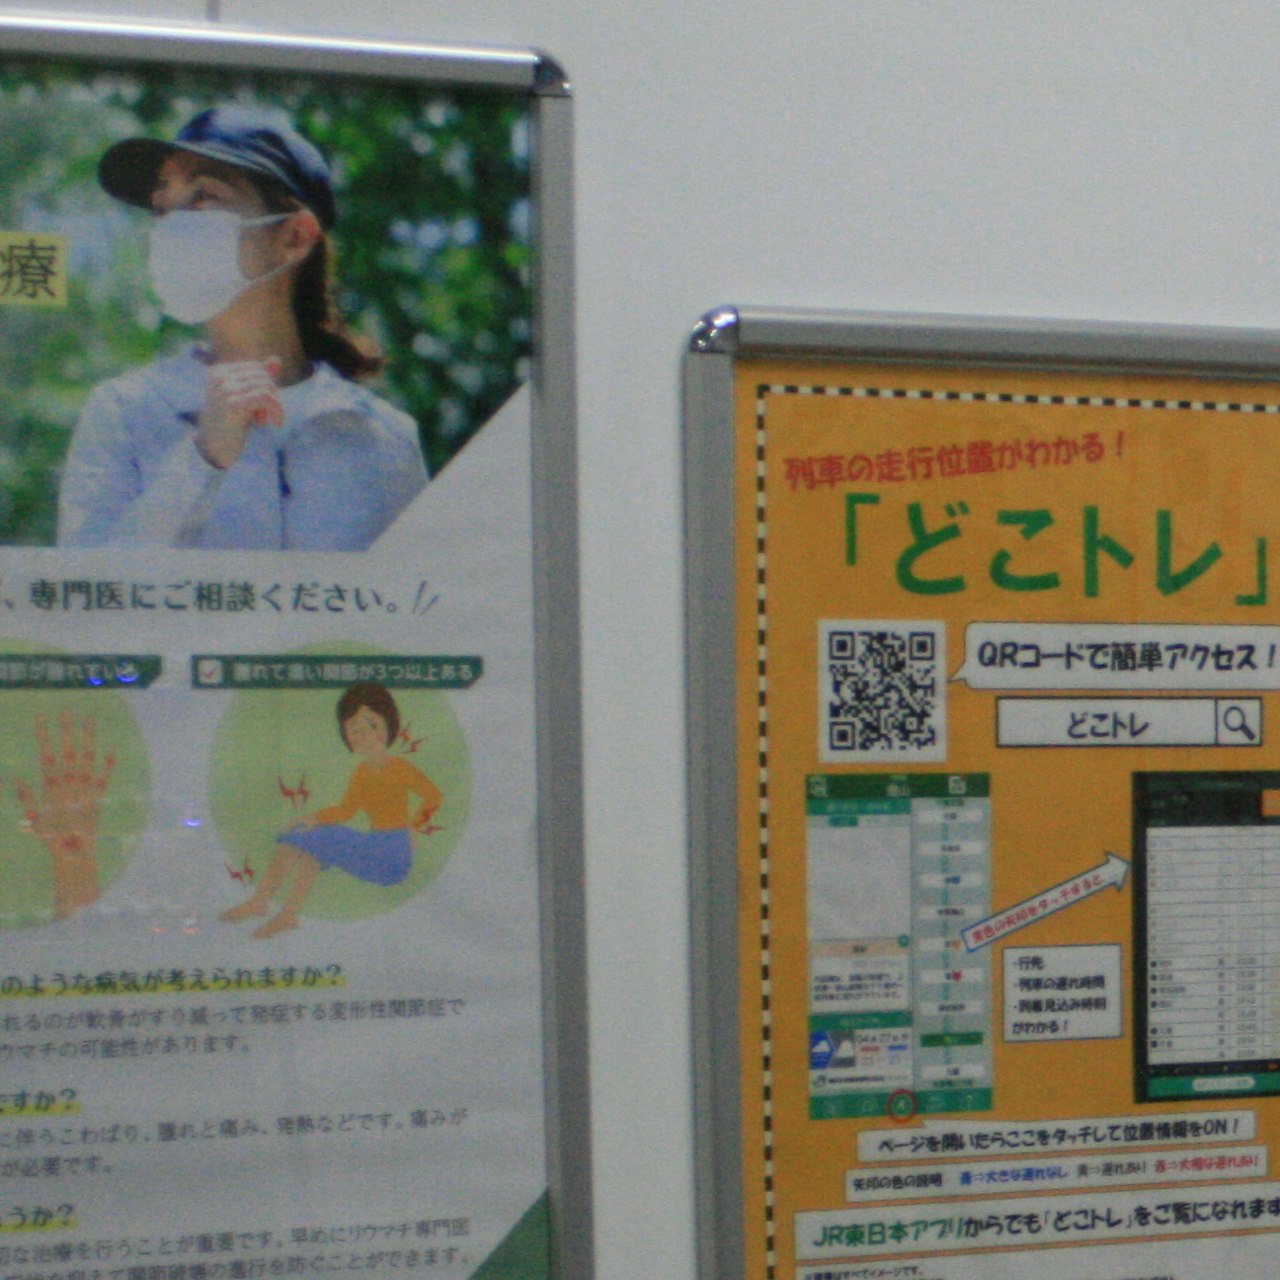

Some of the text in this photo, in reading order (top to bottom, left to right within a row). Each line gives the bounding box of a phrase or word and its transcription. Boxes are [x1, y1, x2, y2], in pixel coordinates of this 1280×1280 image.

[844, 492, 1269, 606] 「どこトレ」
[977, 641, 1279, 673] QRコードで簡単アクセス！
[1066, 712, 1150, 740] どこトレ
[0, 1203, 75, 1230] うか？
